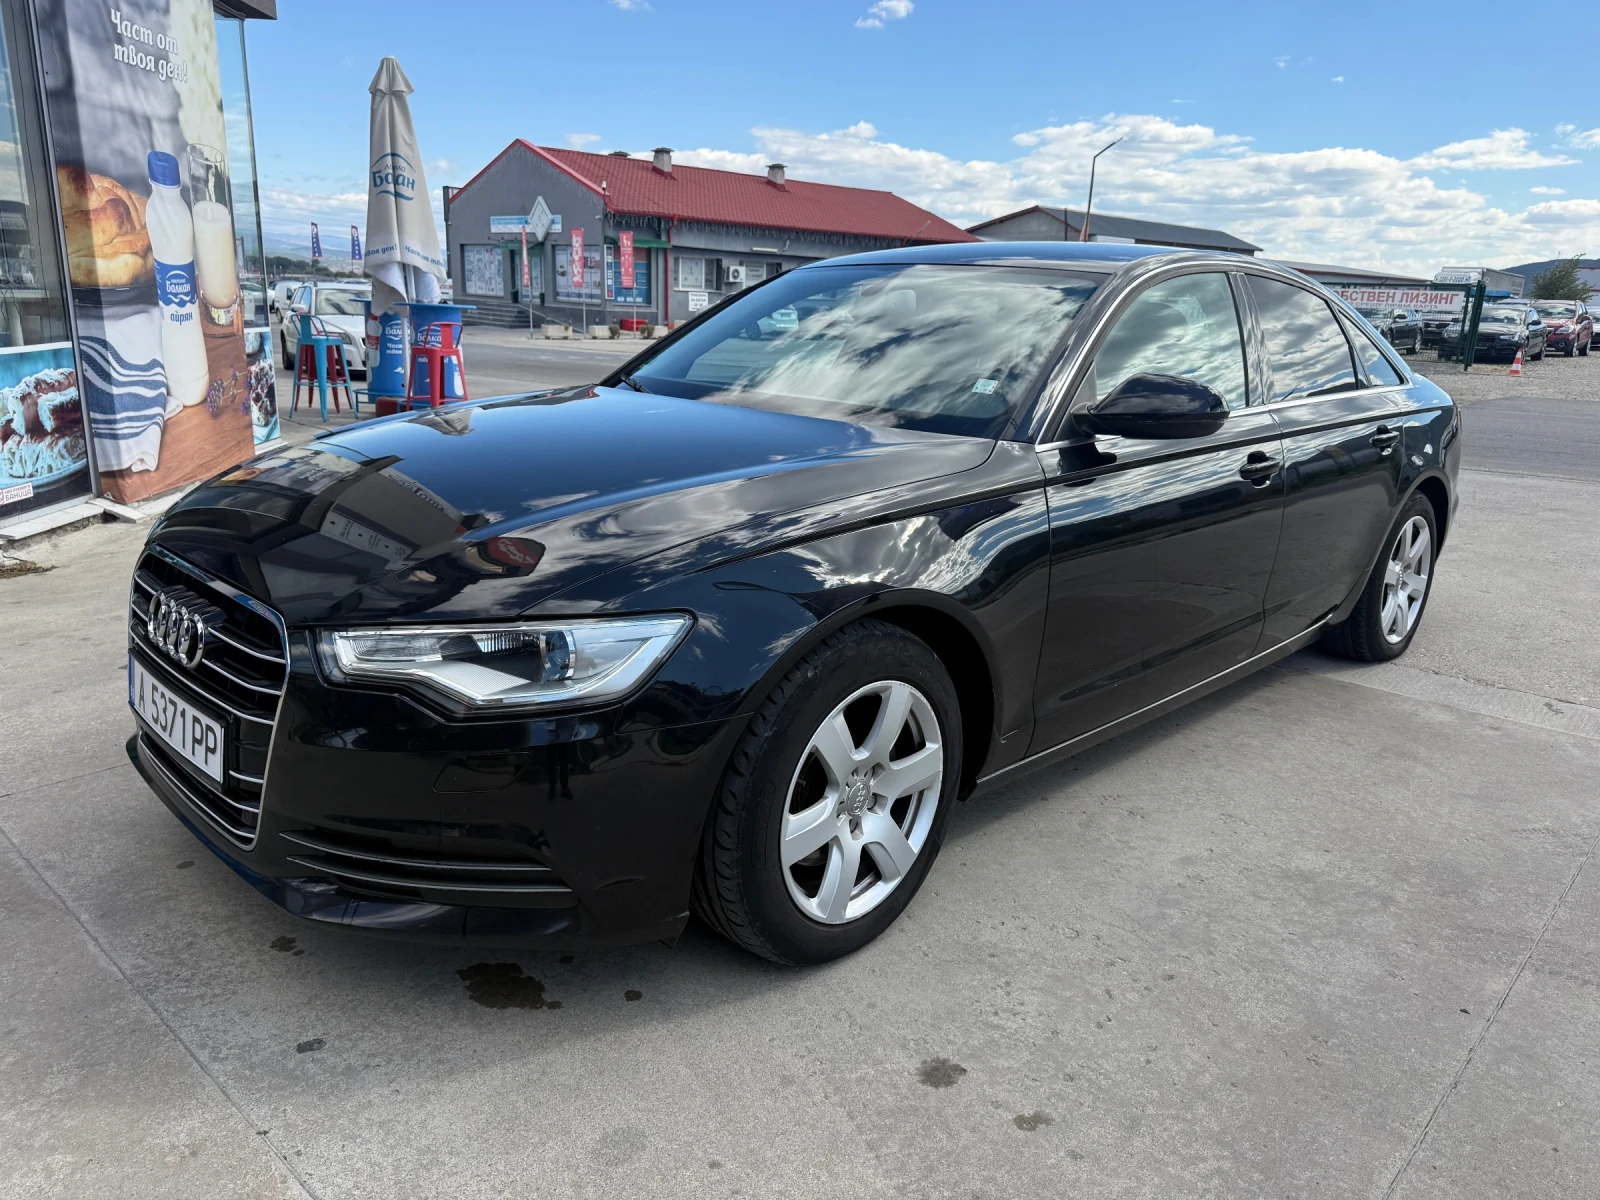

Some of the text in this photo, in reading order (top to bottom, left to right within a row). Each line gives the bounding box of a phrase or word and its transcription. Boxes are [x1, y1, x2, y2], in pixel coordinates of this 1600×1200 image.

[110, 8, 178, 55] Част от
[113, 43, 188, 83] твоя ден!
[166, 280, 190, 293] Балкан
[1399, 291, 1459, 305] ЛИЗИНГ
[170, 310, 193, 325] айрян
[417, 332, 442, 342] Балка
[5, 489, 32, 501] БАНИЦА
[151, 682, 187, 751] 5371
